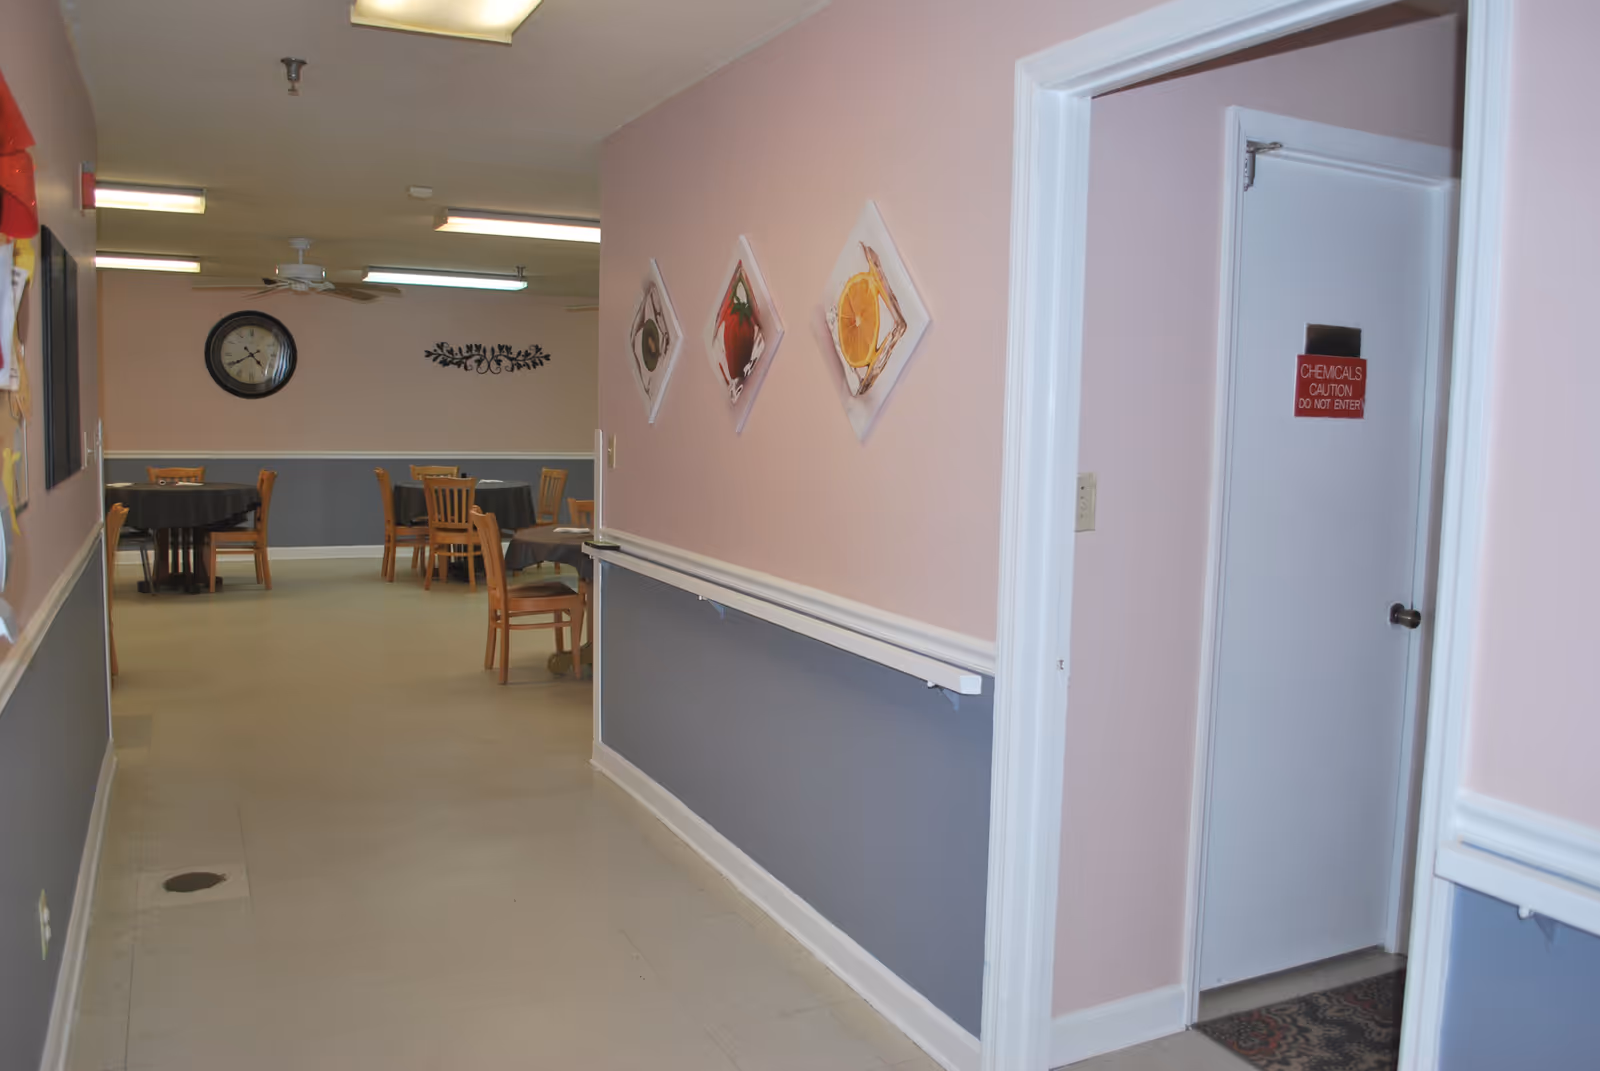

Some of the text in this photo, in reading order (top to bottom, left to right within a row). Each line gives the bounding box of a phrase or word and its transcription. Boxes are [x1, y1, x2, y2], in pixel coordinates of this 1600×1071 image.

[1300, 363, 1362, 381] CHEMICALS
[1309, 382, 1352, 397] CAUTION
[1298, 398, 1361, 410] DO NOT ENTER
